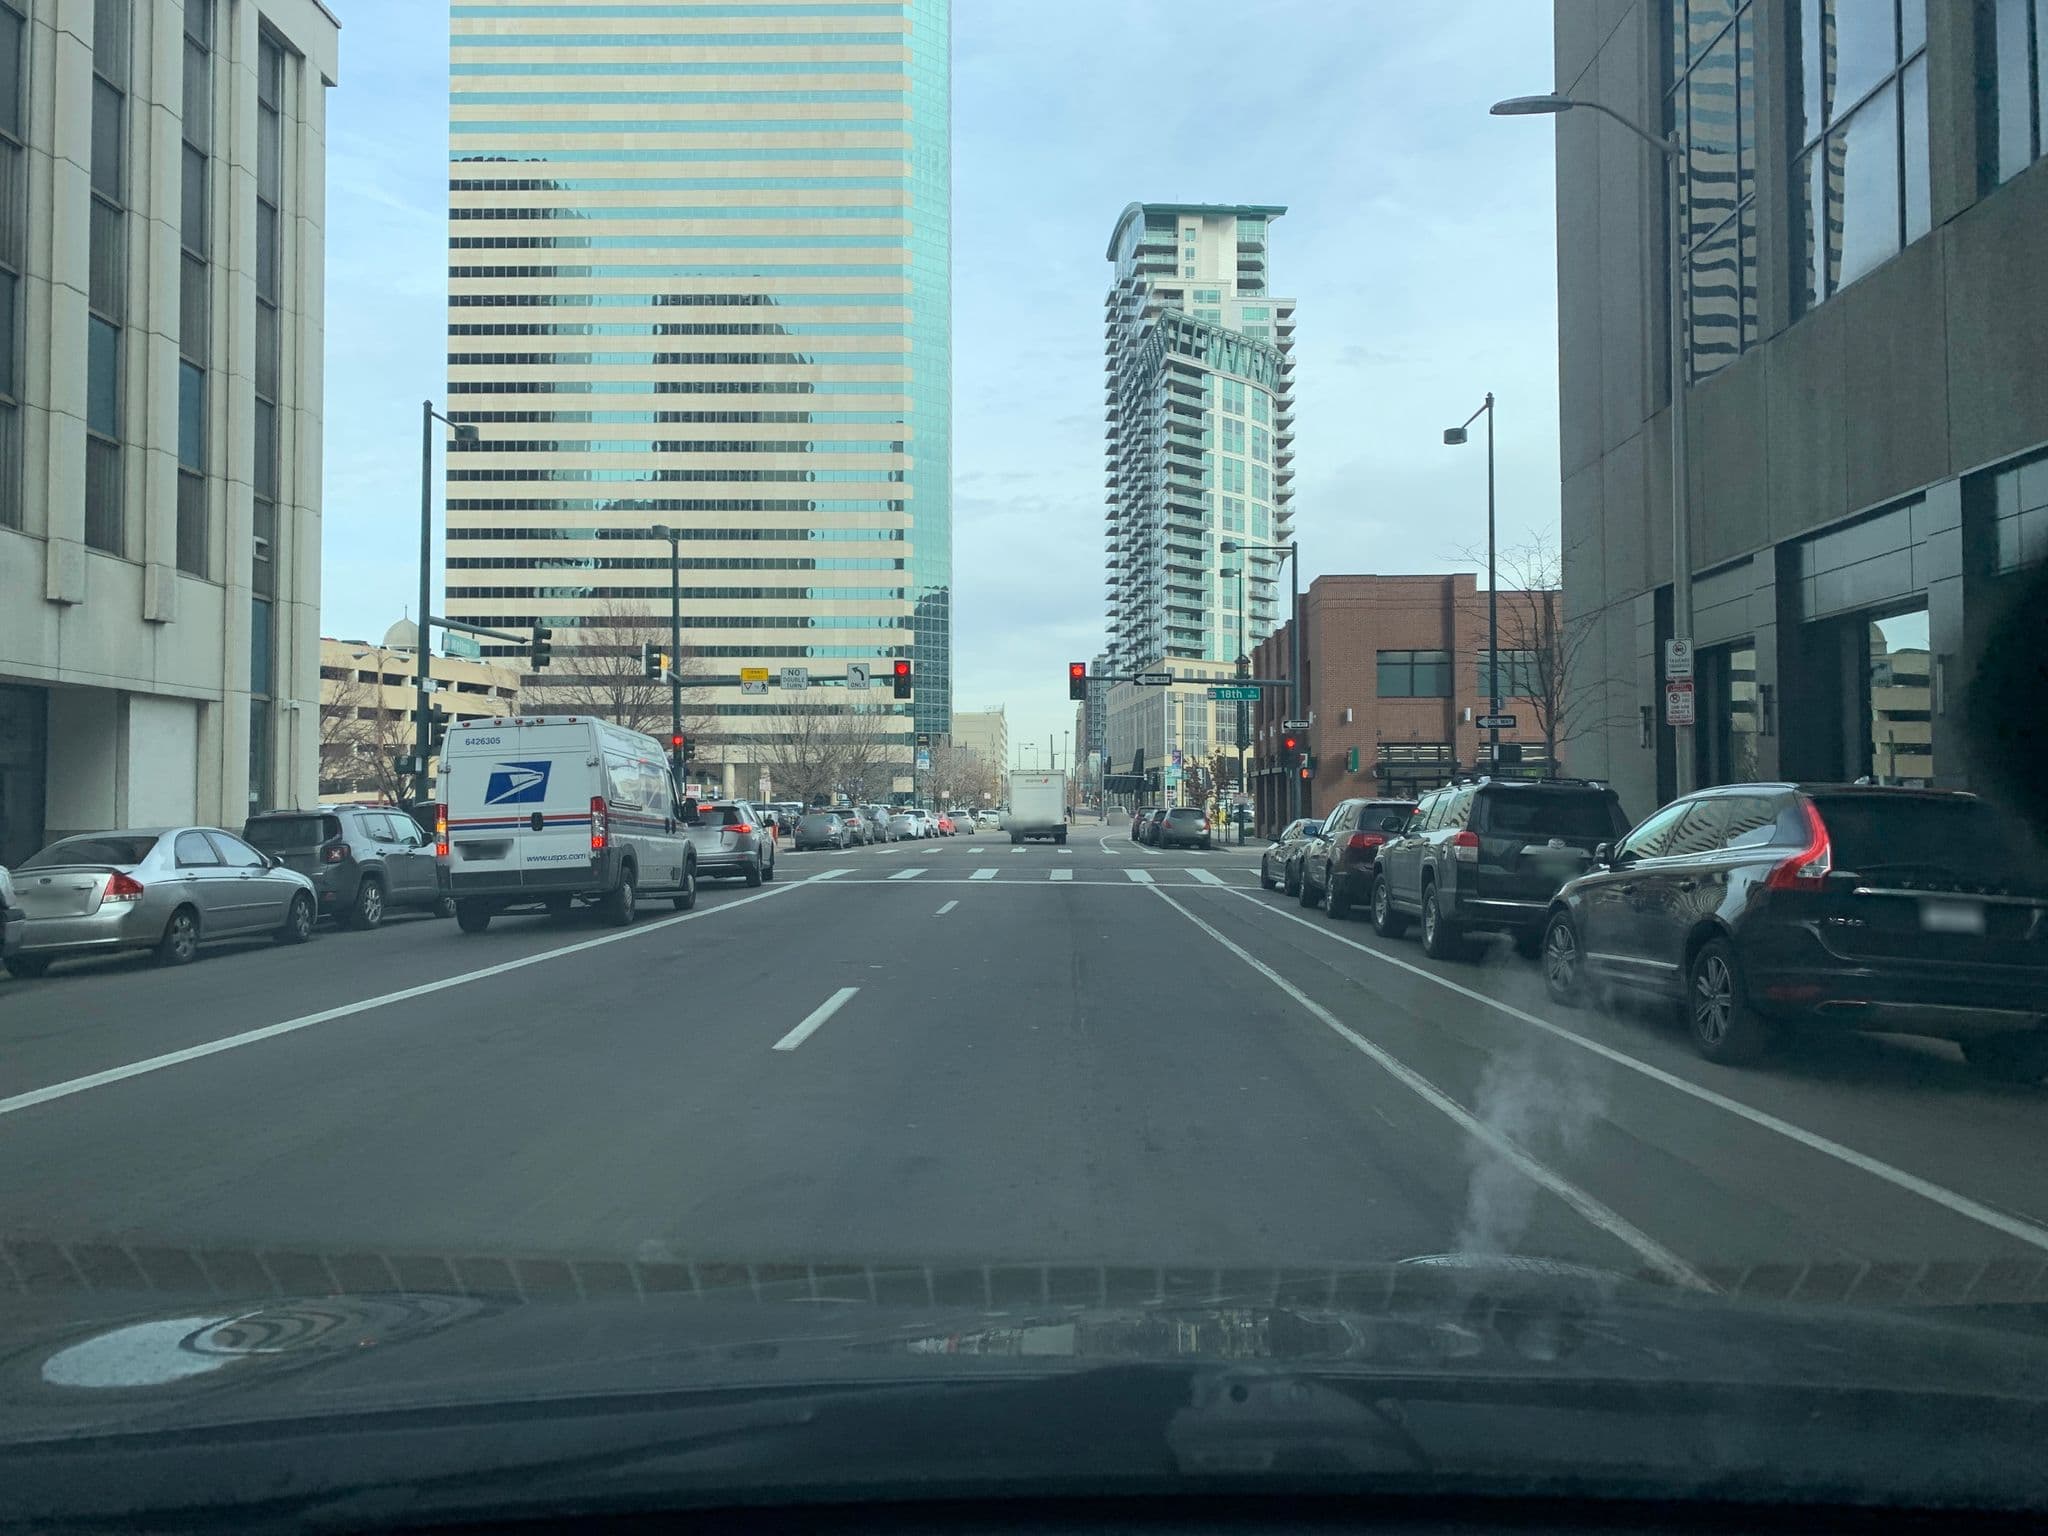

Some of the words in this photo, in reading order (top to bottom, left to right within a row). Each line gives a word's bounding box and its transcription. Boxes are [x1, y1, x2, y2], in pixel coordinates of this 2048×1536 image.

[1220, 689, 1243, 699] 18th
[465, 736, 501, 746] 6426305
[526, 853, 586, 863] www.usps.com
